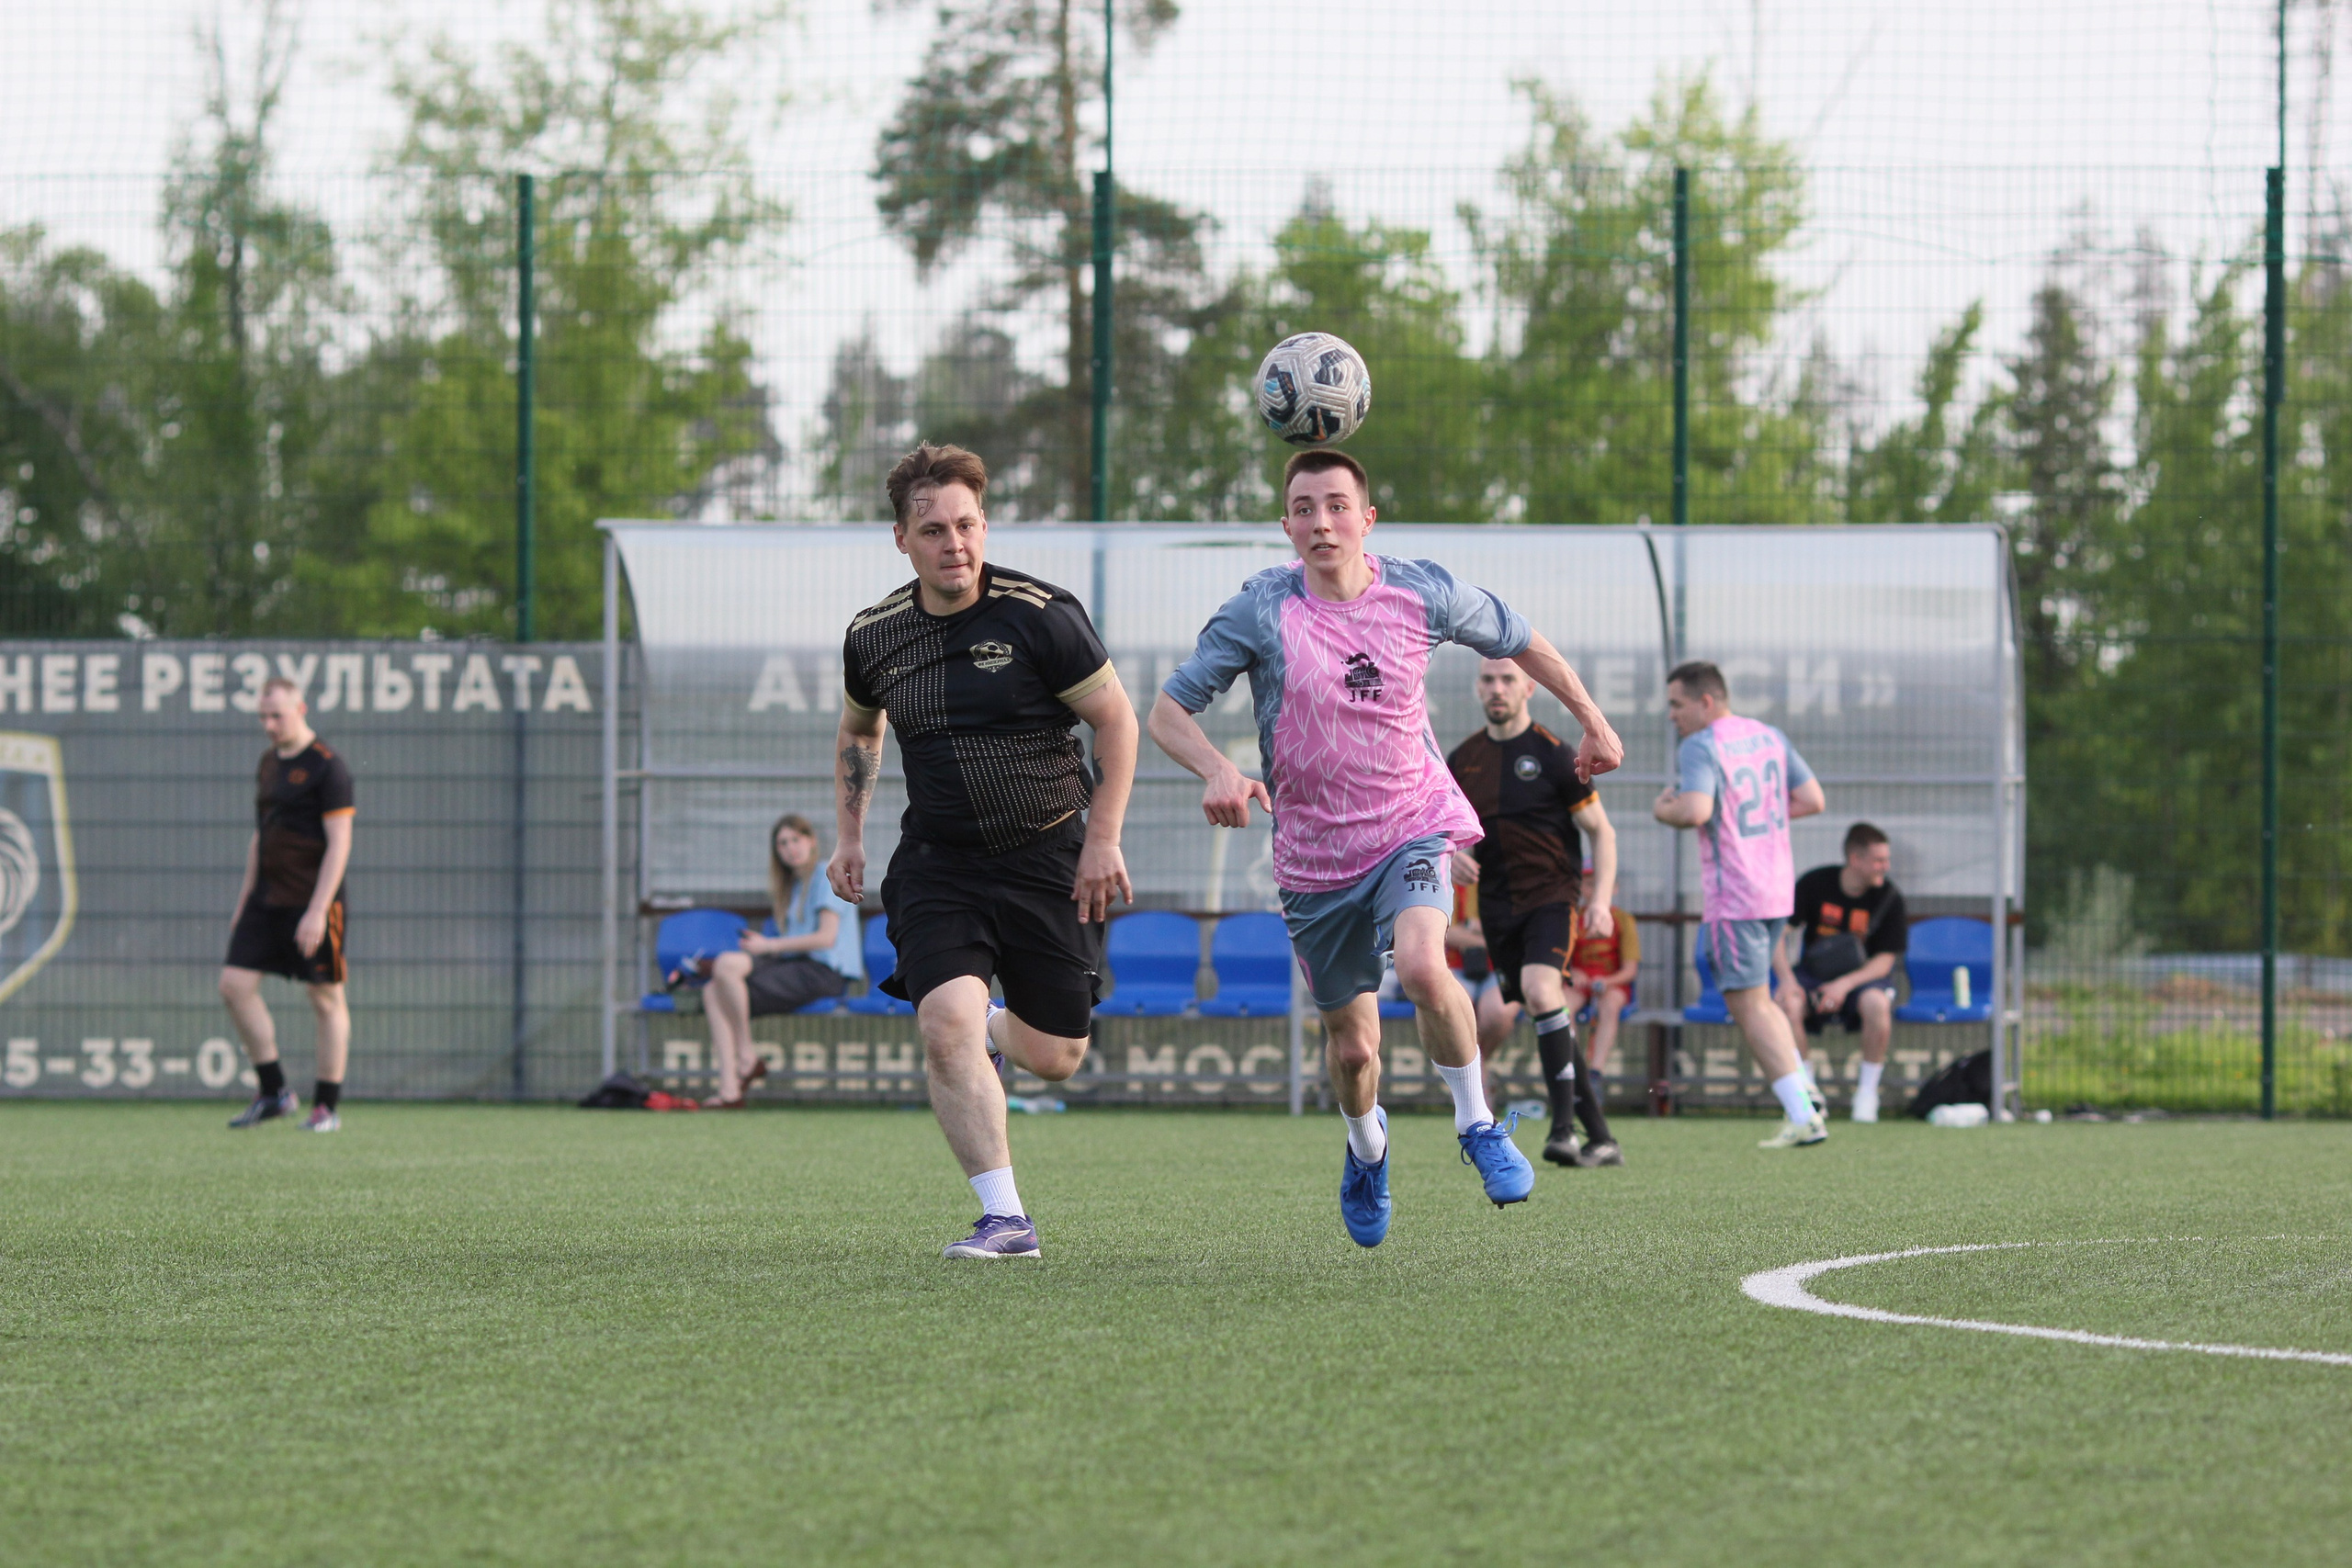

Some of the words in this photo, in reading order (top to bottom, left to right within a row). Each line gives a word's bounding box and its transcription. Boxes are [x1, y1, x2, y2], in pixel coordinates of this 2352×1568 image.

[141, 652, 594, 714] РЕЗУЛЬТАТА
[1349, 689, 1382, 703] JFF
[1733, 759, 1784, 838] 23
[1408, 882, 1440, 894] JFF
